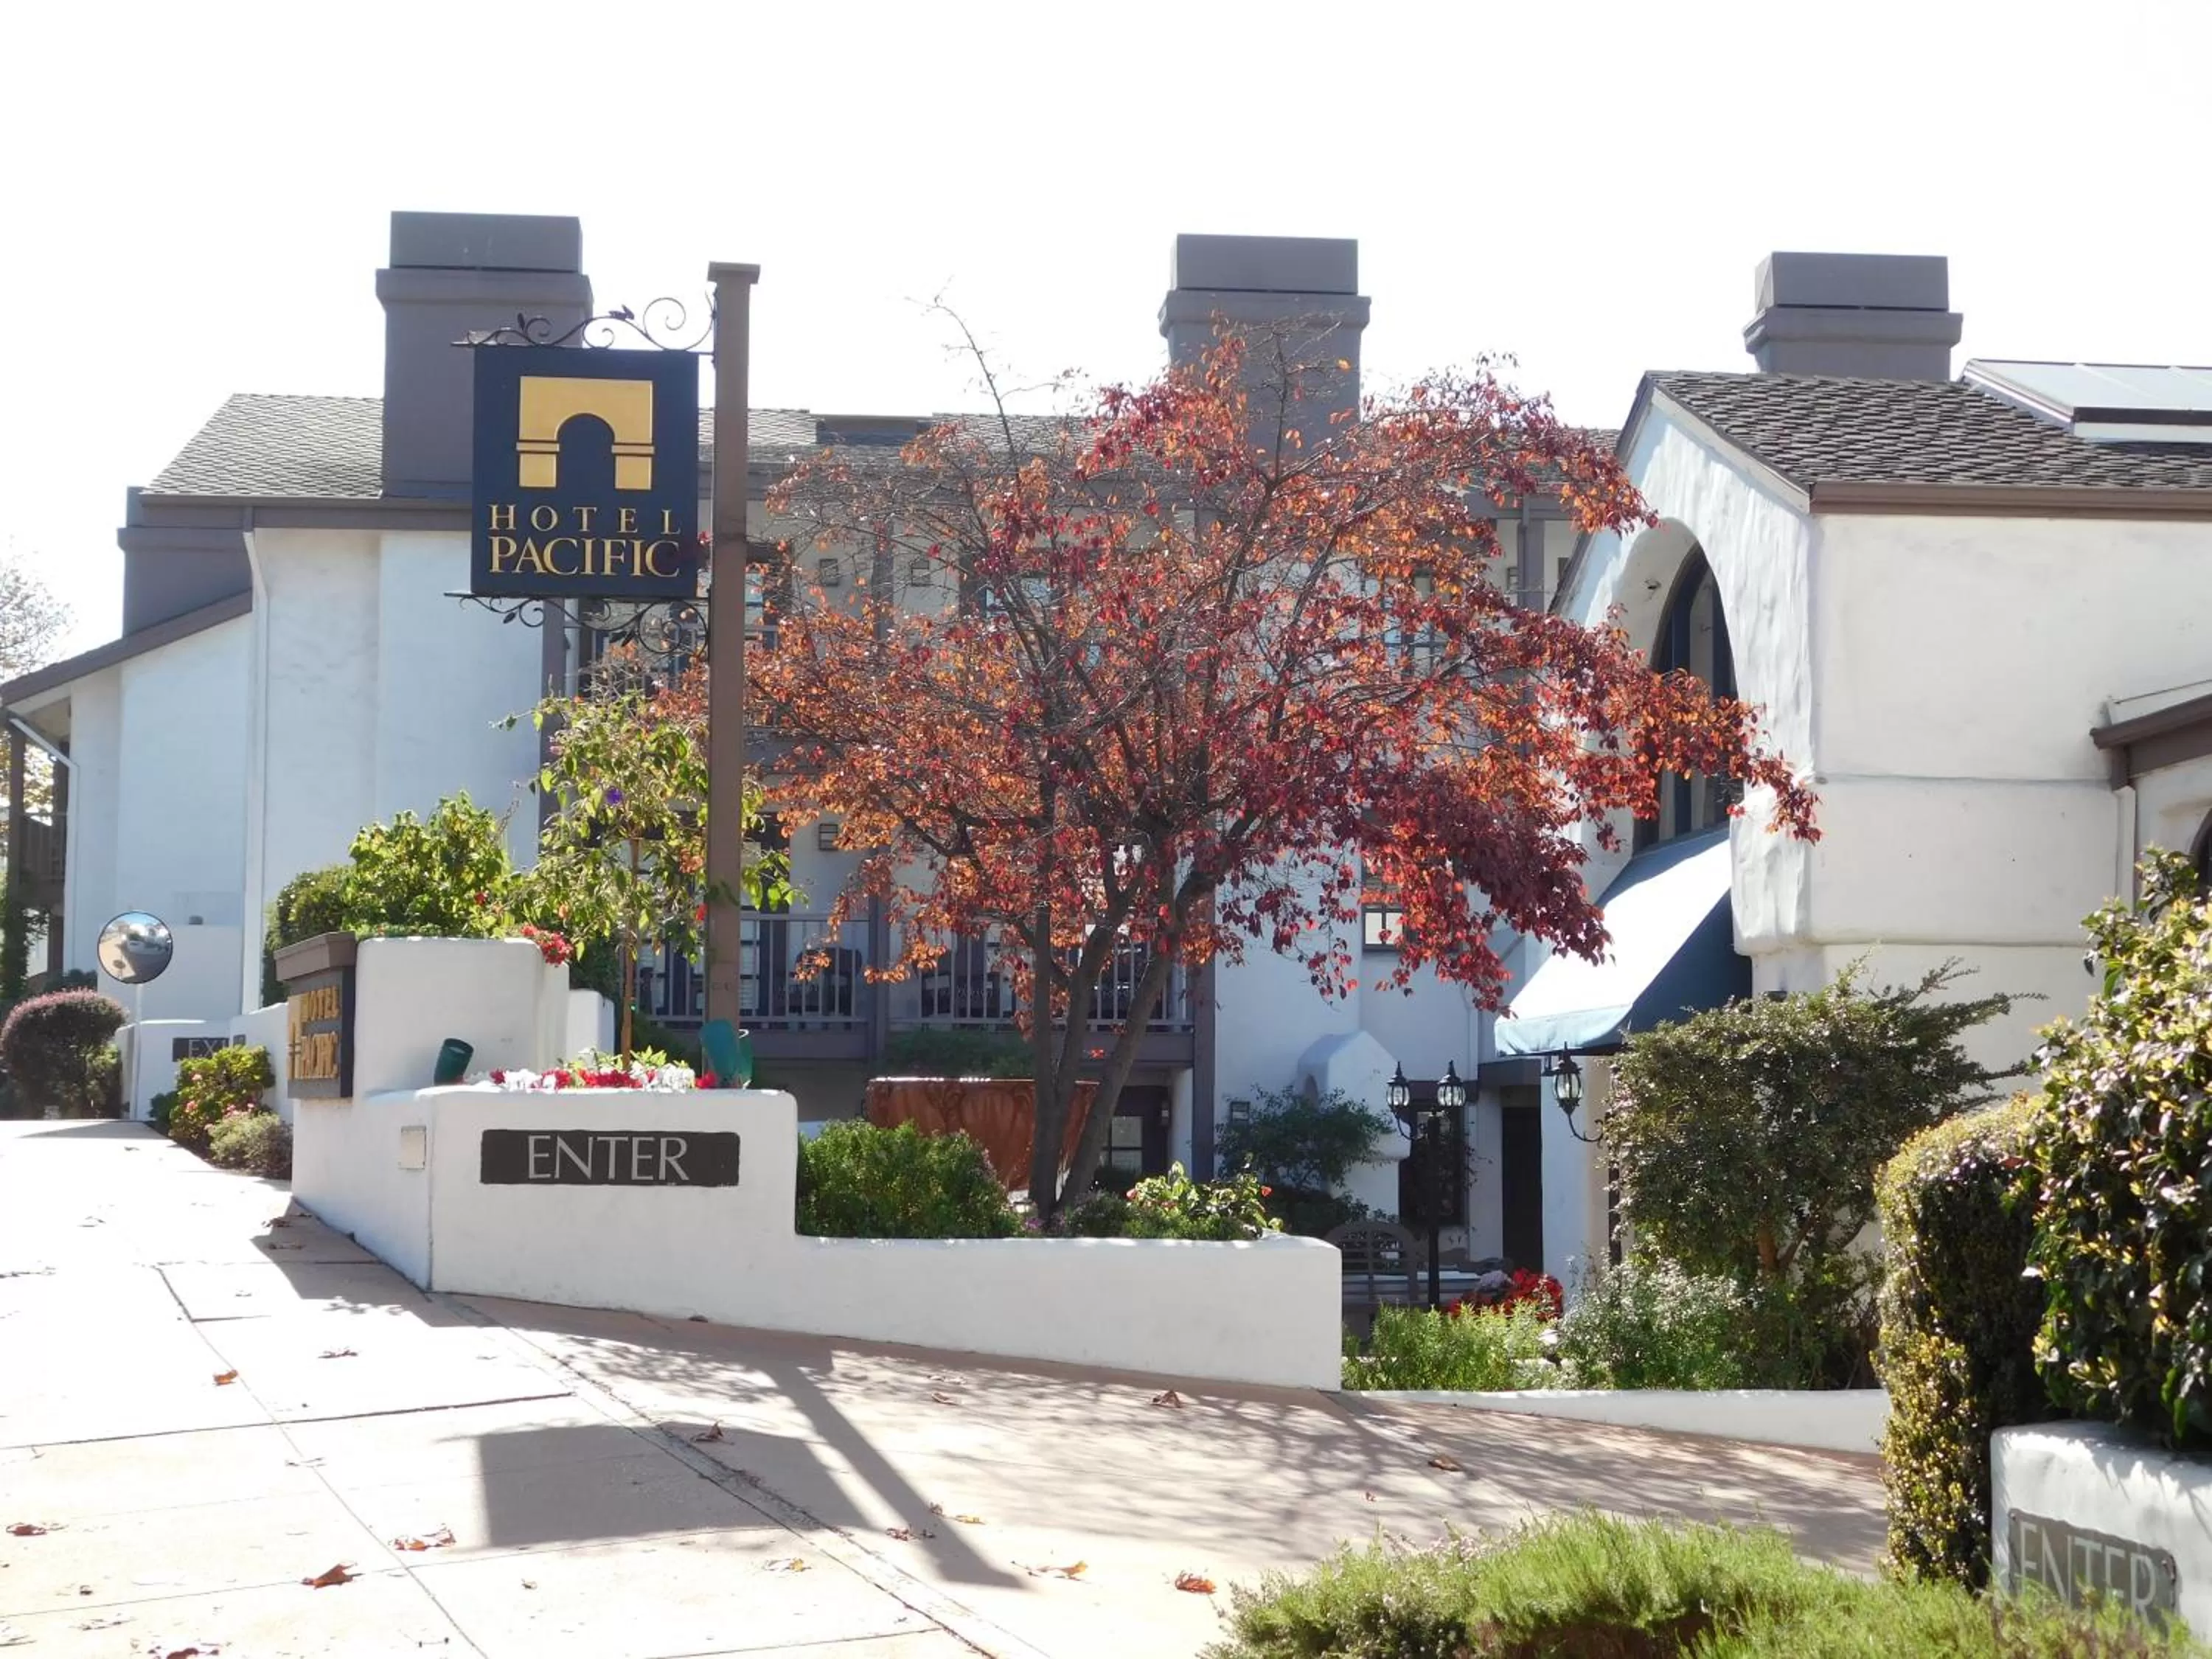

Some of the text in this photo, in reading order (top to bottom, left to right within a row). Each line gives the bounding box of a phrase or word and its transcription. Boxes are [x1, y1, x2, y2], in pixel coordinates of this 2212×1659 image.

[488, 504, 680, 535] HOTEL
[489, 536, 680, 577] PACIFIC
[300, 986, 339, 1022] HOTEL
[528, 1135, 690, 1180] ENTER
[2020, 1520, 2157, 1628] ENTER
